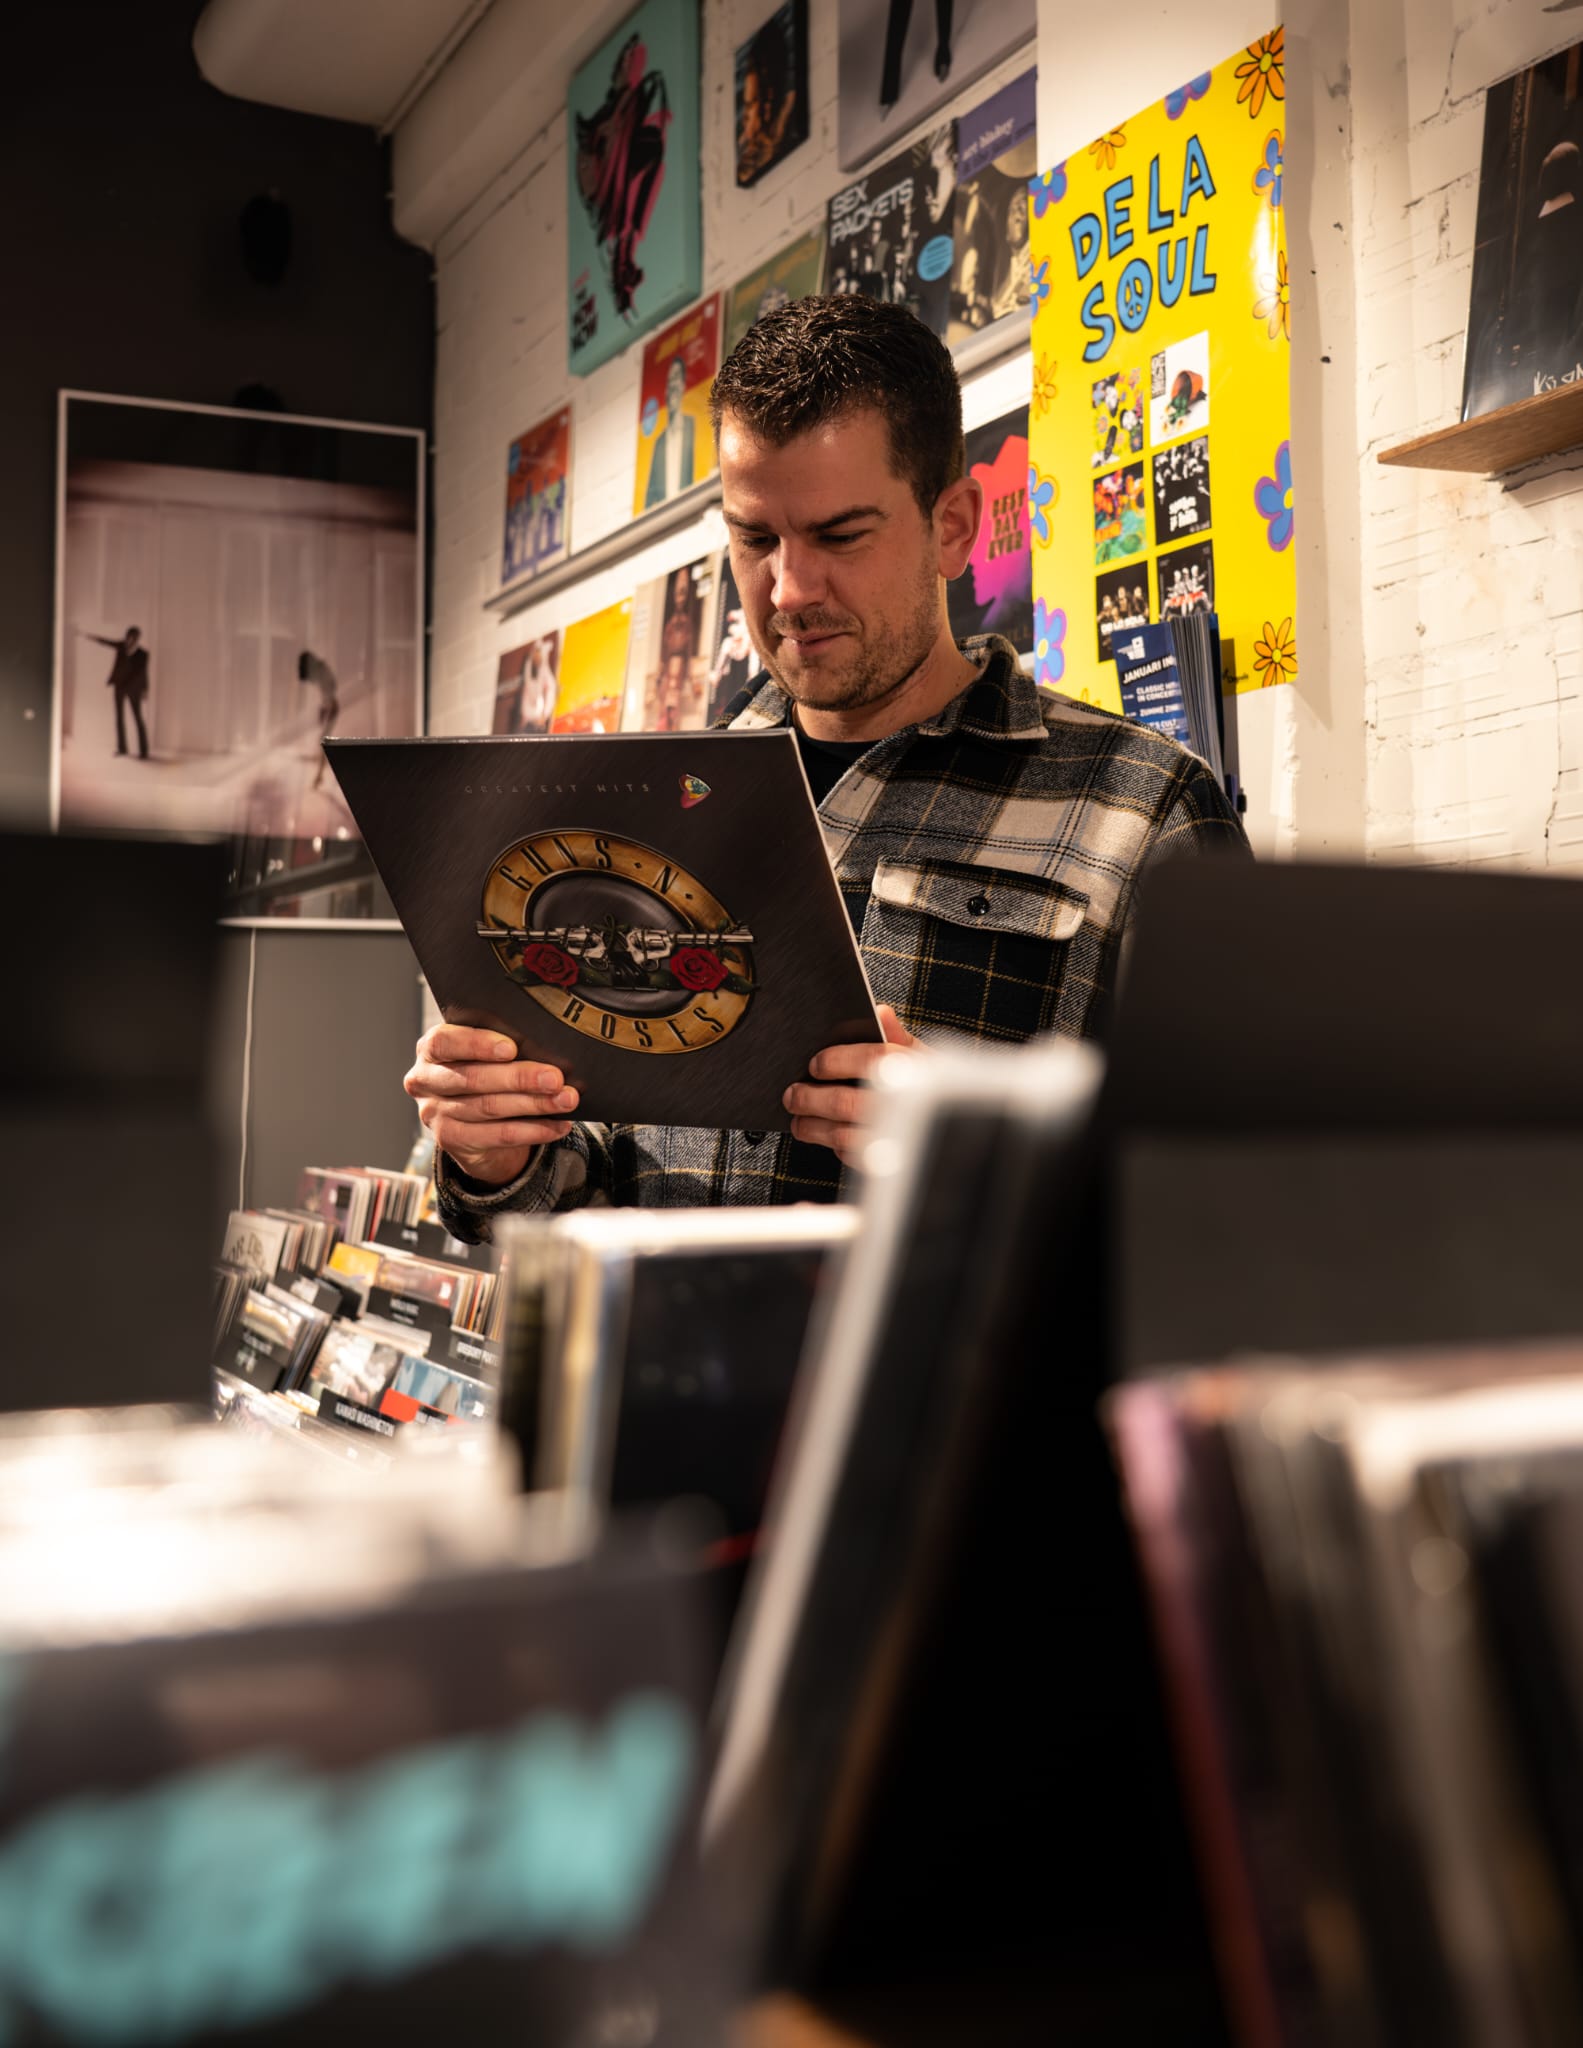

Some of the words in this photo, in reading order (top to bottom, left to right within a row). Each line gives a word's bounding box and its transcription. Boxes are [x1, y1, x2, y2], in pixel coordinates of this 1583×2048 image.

[832, 180, 869, 220] SEX
[1069, 175, 1134, 281] DE
[1147, 134, 1217, 235] LA
[1081, 223, 1217, 363] SOUL
[987, 530, 1023, 562] EVER
[1123, 660, 1162, 684] JANUARI
[464, 783, 578, 794] GREATEST
[596, 782, 650, 793] HITS
[499, 838, 612, 891] GUNS
[652, 865, 680, 895] N
[561, 996, 726, 1048] ROSES
